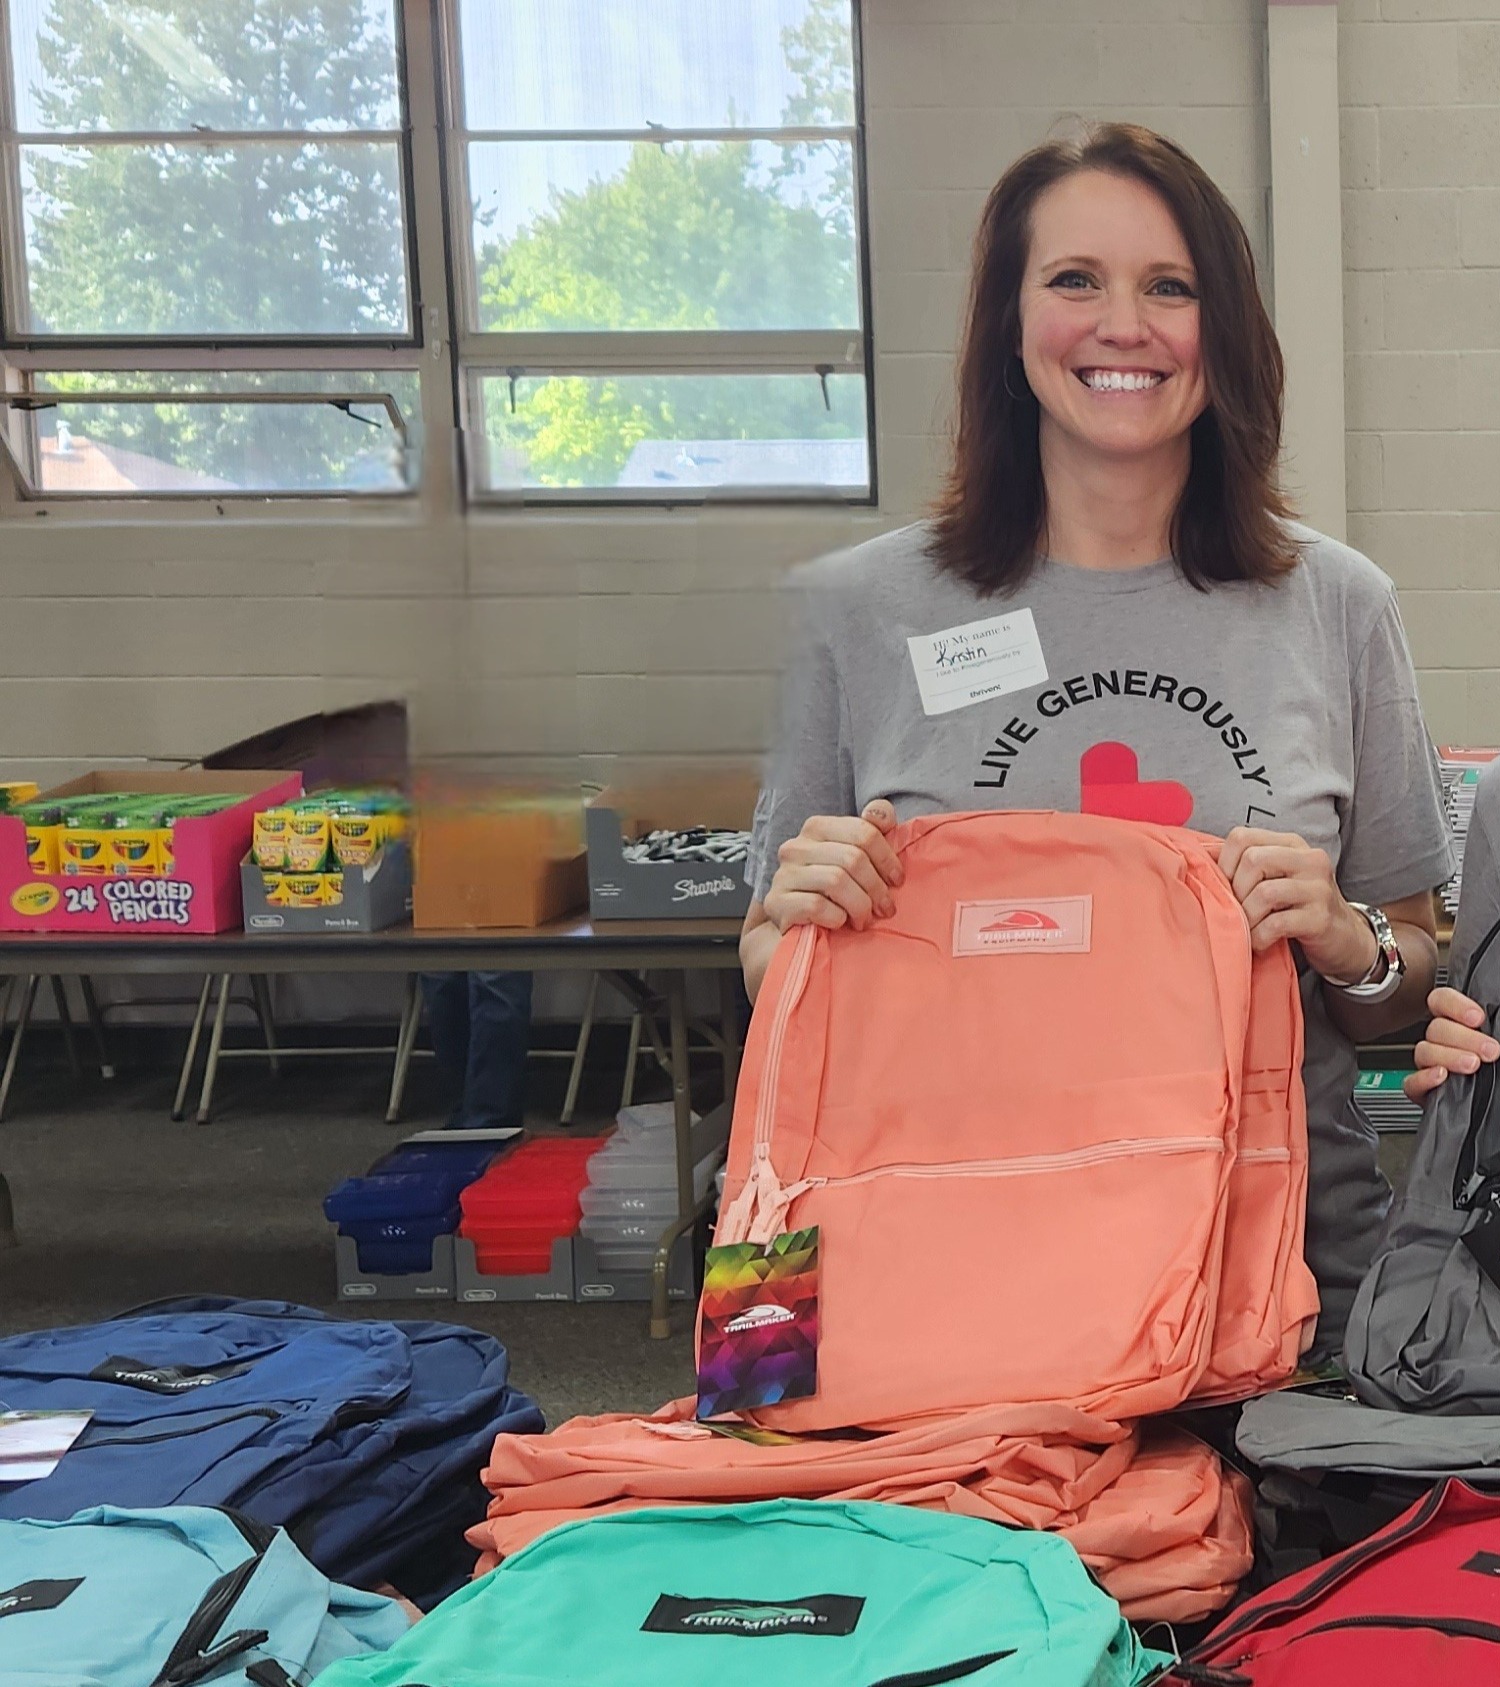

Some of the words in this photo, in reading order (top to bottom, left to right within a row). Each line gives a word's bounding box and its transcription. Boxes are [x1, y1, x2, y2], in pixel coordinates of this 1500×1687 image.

[951, 634, 969, 646] My
[972, 628, 1000, 640] name
[969, 684, 1001, 698] thrivent
[974, 717, 1039, 789] LIVE
[1036, 670, 1273, 789] GENEROUSLY
[64, 884, 98, 913] 24
[103, 879, 193, 901] COLORED
[671, 875, 735, 902] Sharpie
[108, 900, 190, 925] PENCILS
[723, 1313, 795, 1333] TRAILMAKER
